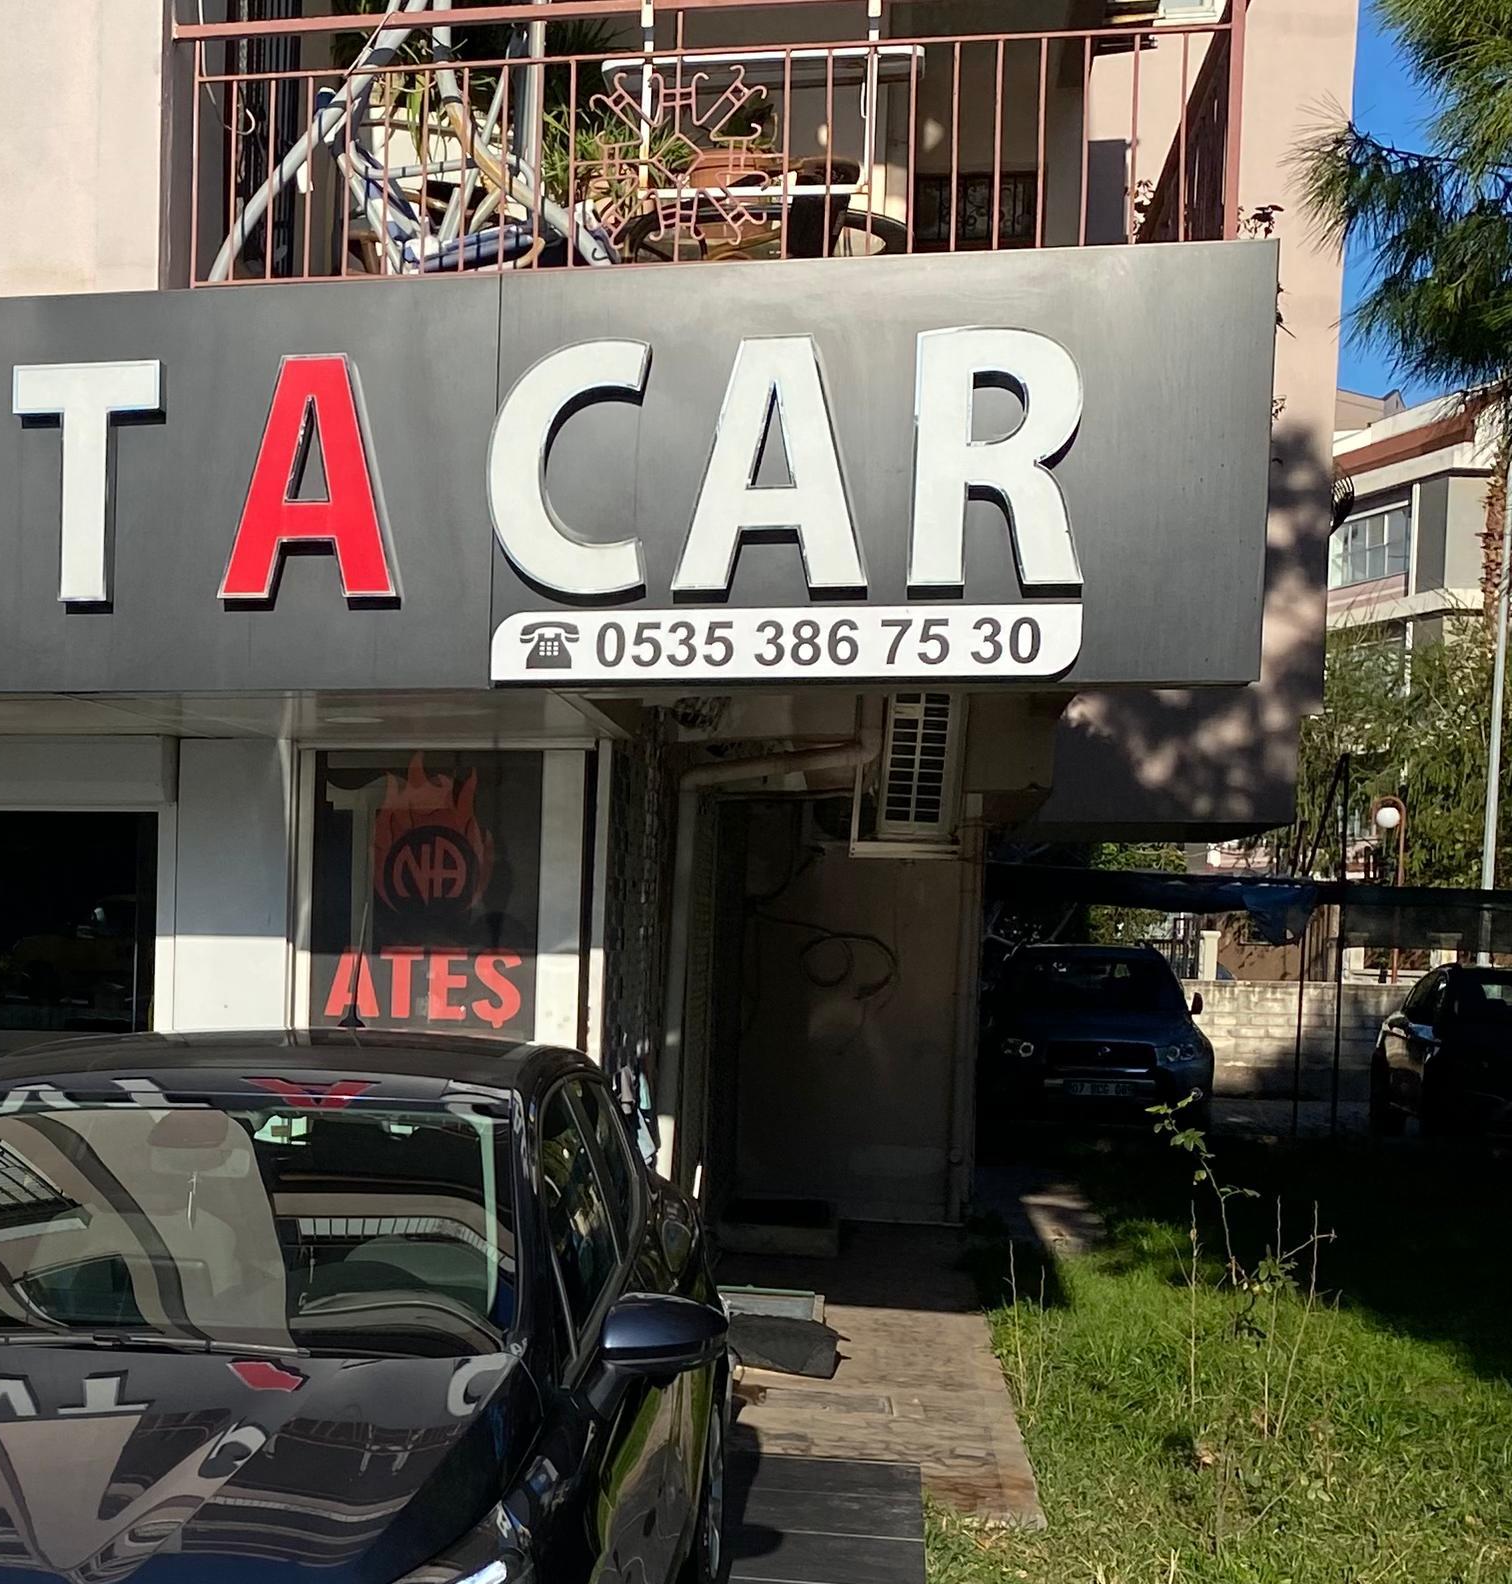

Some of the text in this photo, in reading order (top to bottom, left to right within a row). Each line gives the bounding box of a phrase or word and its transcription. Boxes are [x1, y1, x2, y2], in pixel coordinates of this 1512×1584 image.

[218, 352, 397, 599] A
[488, 326, 1084, 595] CAR
[595, 616, 1042, 668] 0535 386 75 30
